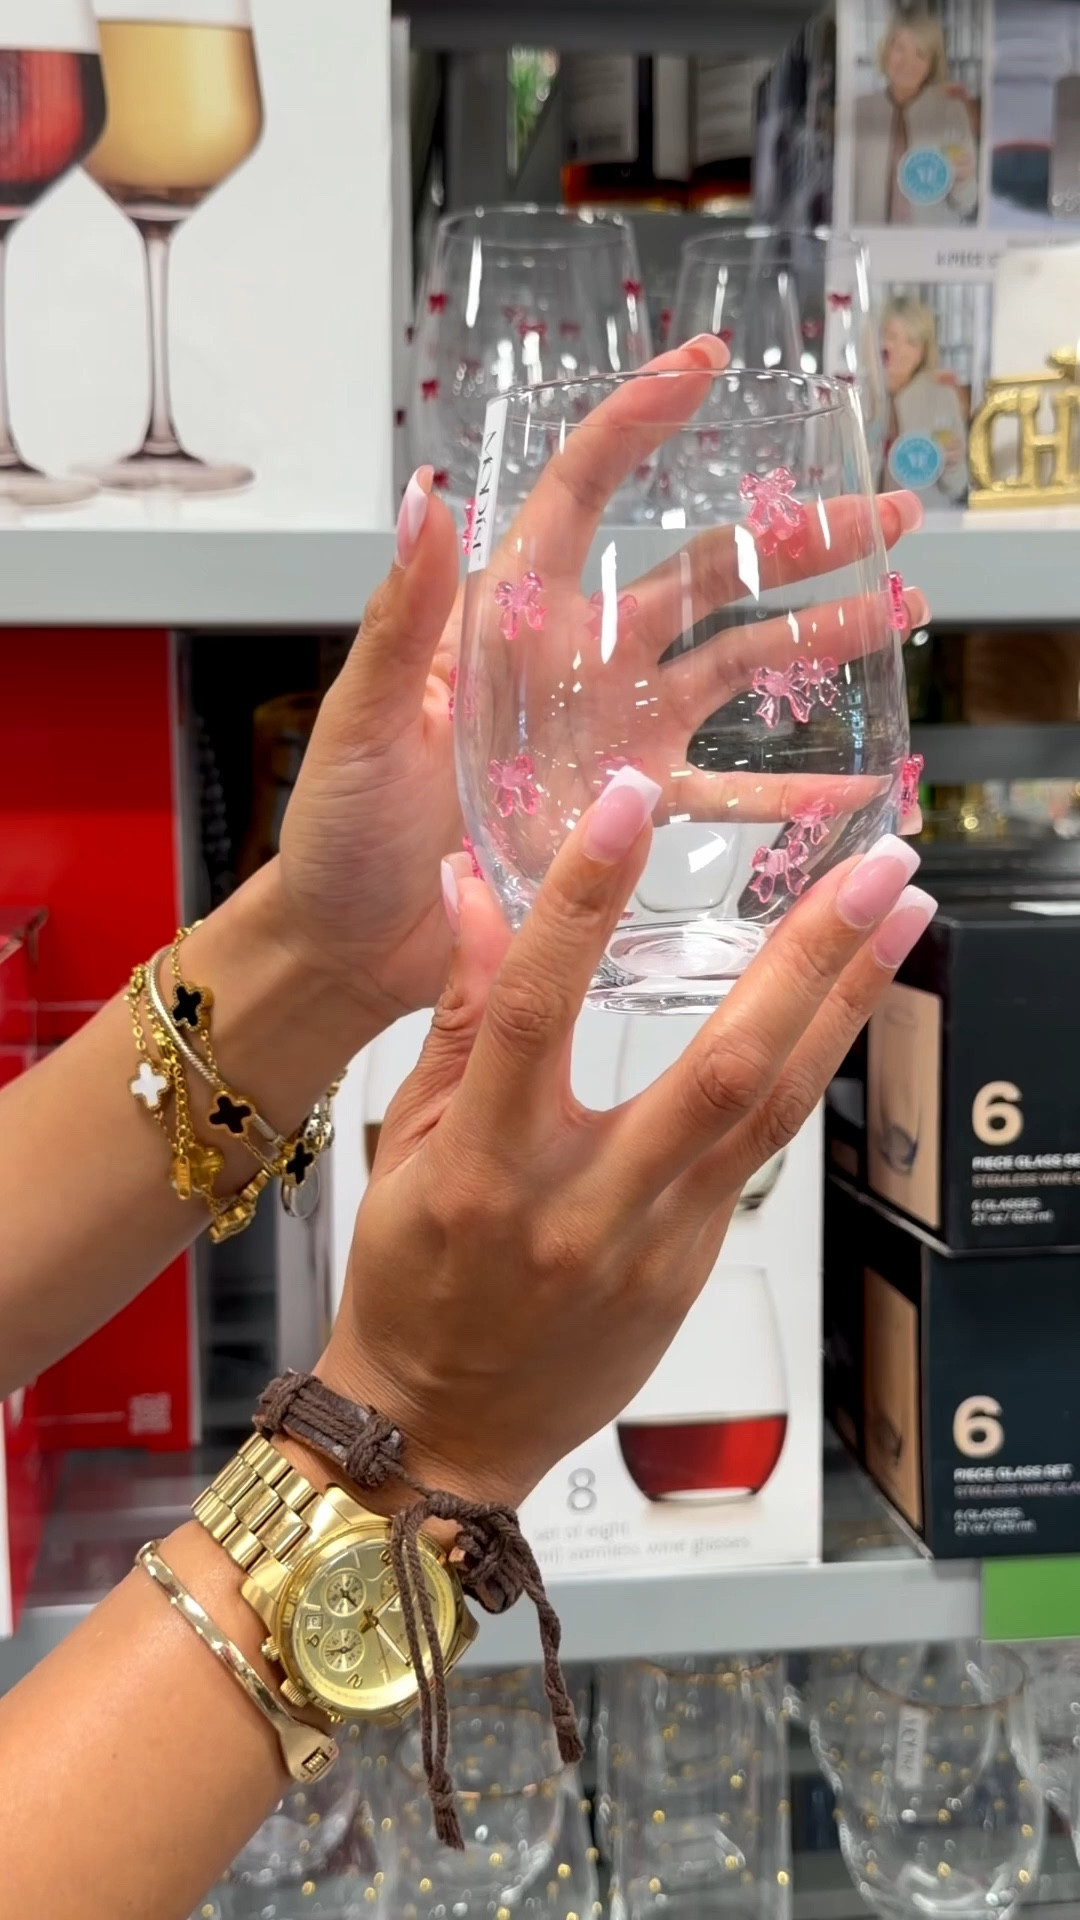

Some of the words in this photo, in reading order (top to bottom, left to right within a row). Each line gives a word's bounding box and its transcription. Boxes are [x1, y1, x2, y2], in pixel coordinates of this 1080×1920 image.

[972, 1080, 1024, 1146] 6
[972, 1156, 1014, 1171] PIECE
[1015, 1154, 1063, 1170] GLASS
[953, 1395, 1005, 1458] 6
[567, 1468, 597, 1511] 8
[954, 1467, 996, 1483] PIECE
[996, 1465, 1043, 1482] GLASS
